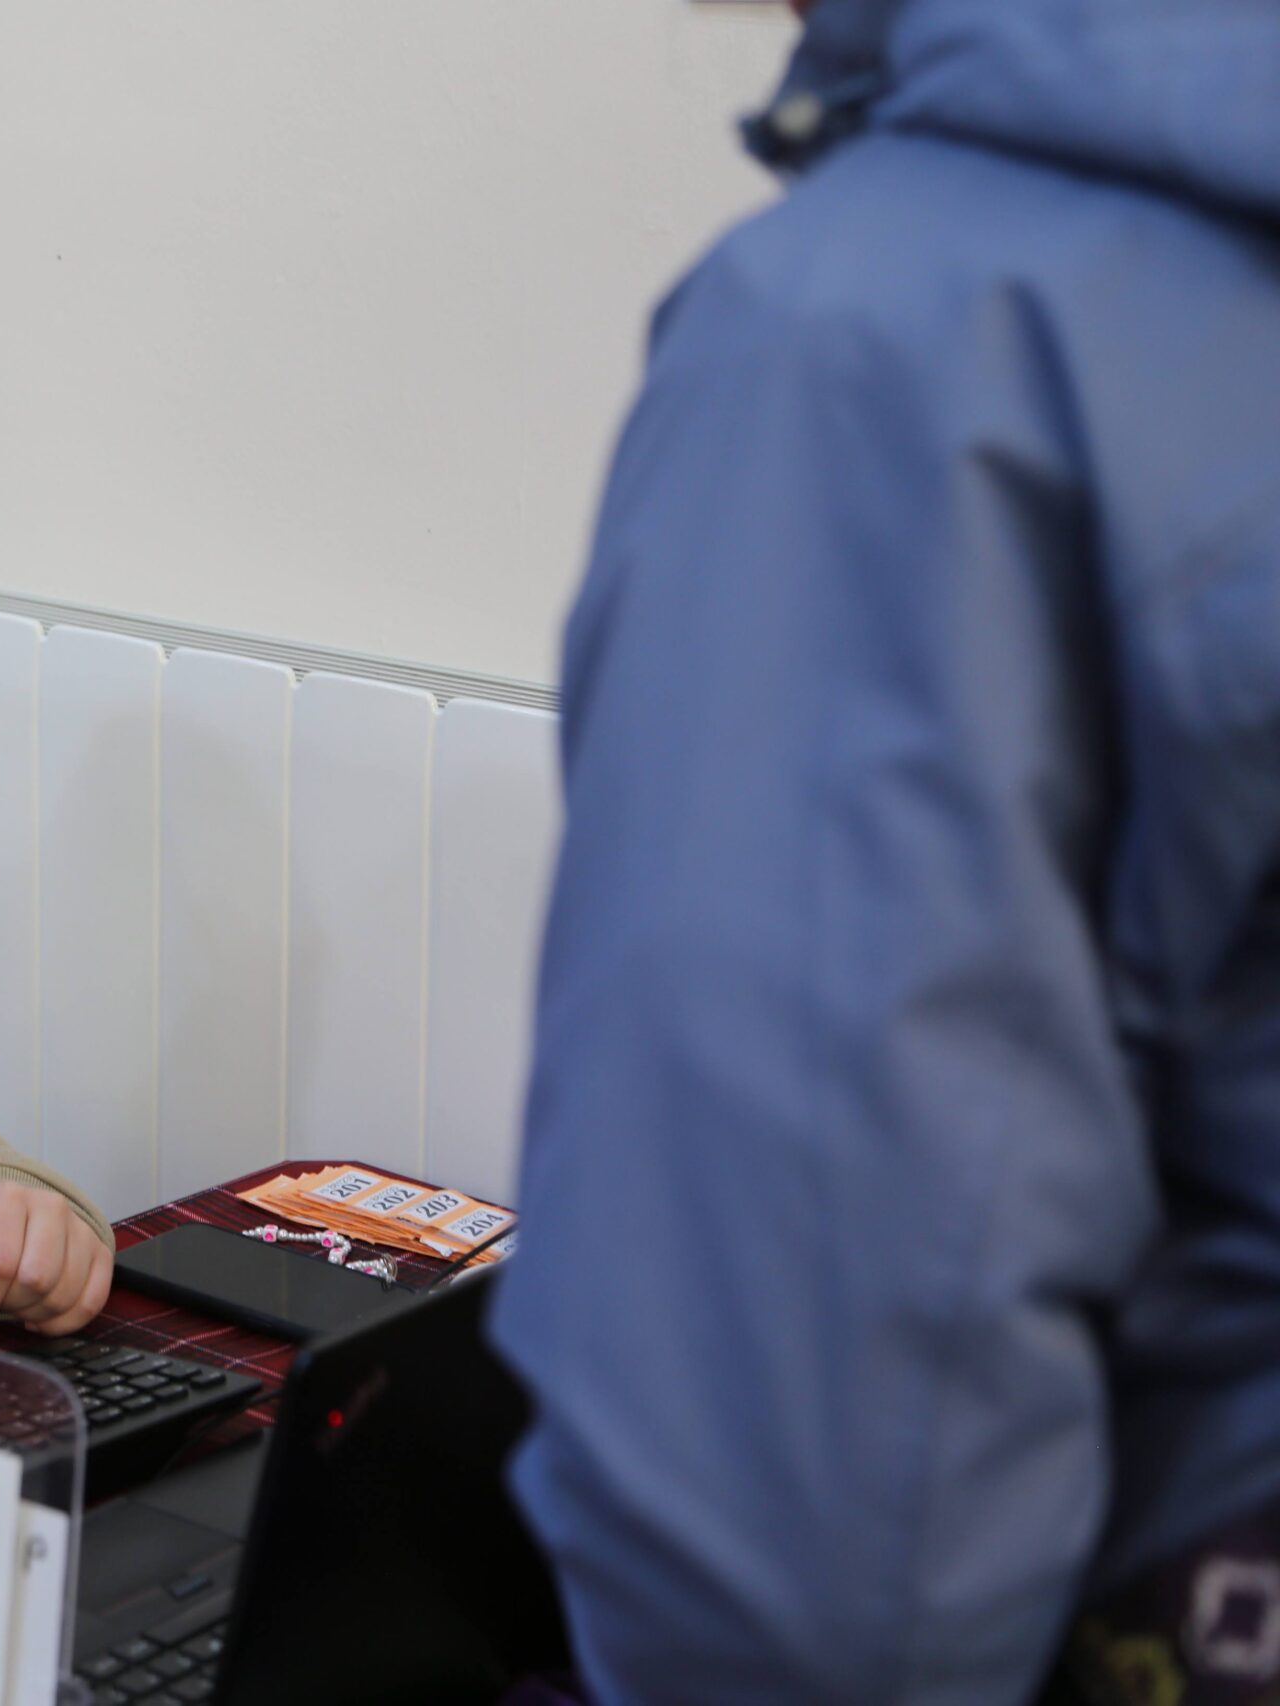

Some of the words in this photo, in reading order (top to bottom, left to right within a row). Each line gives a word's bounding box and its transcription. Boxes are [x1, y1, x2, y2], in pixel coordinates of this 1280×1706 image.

[330, 1178, 372, 1198] 201
[372, 1188, 416, 1211] 202
[416, 1194, 459, 1218] 203
[460, 1213, 504, 1237] 204
